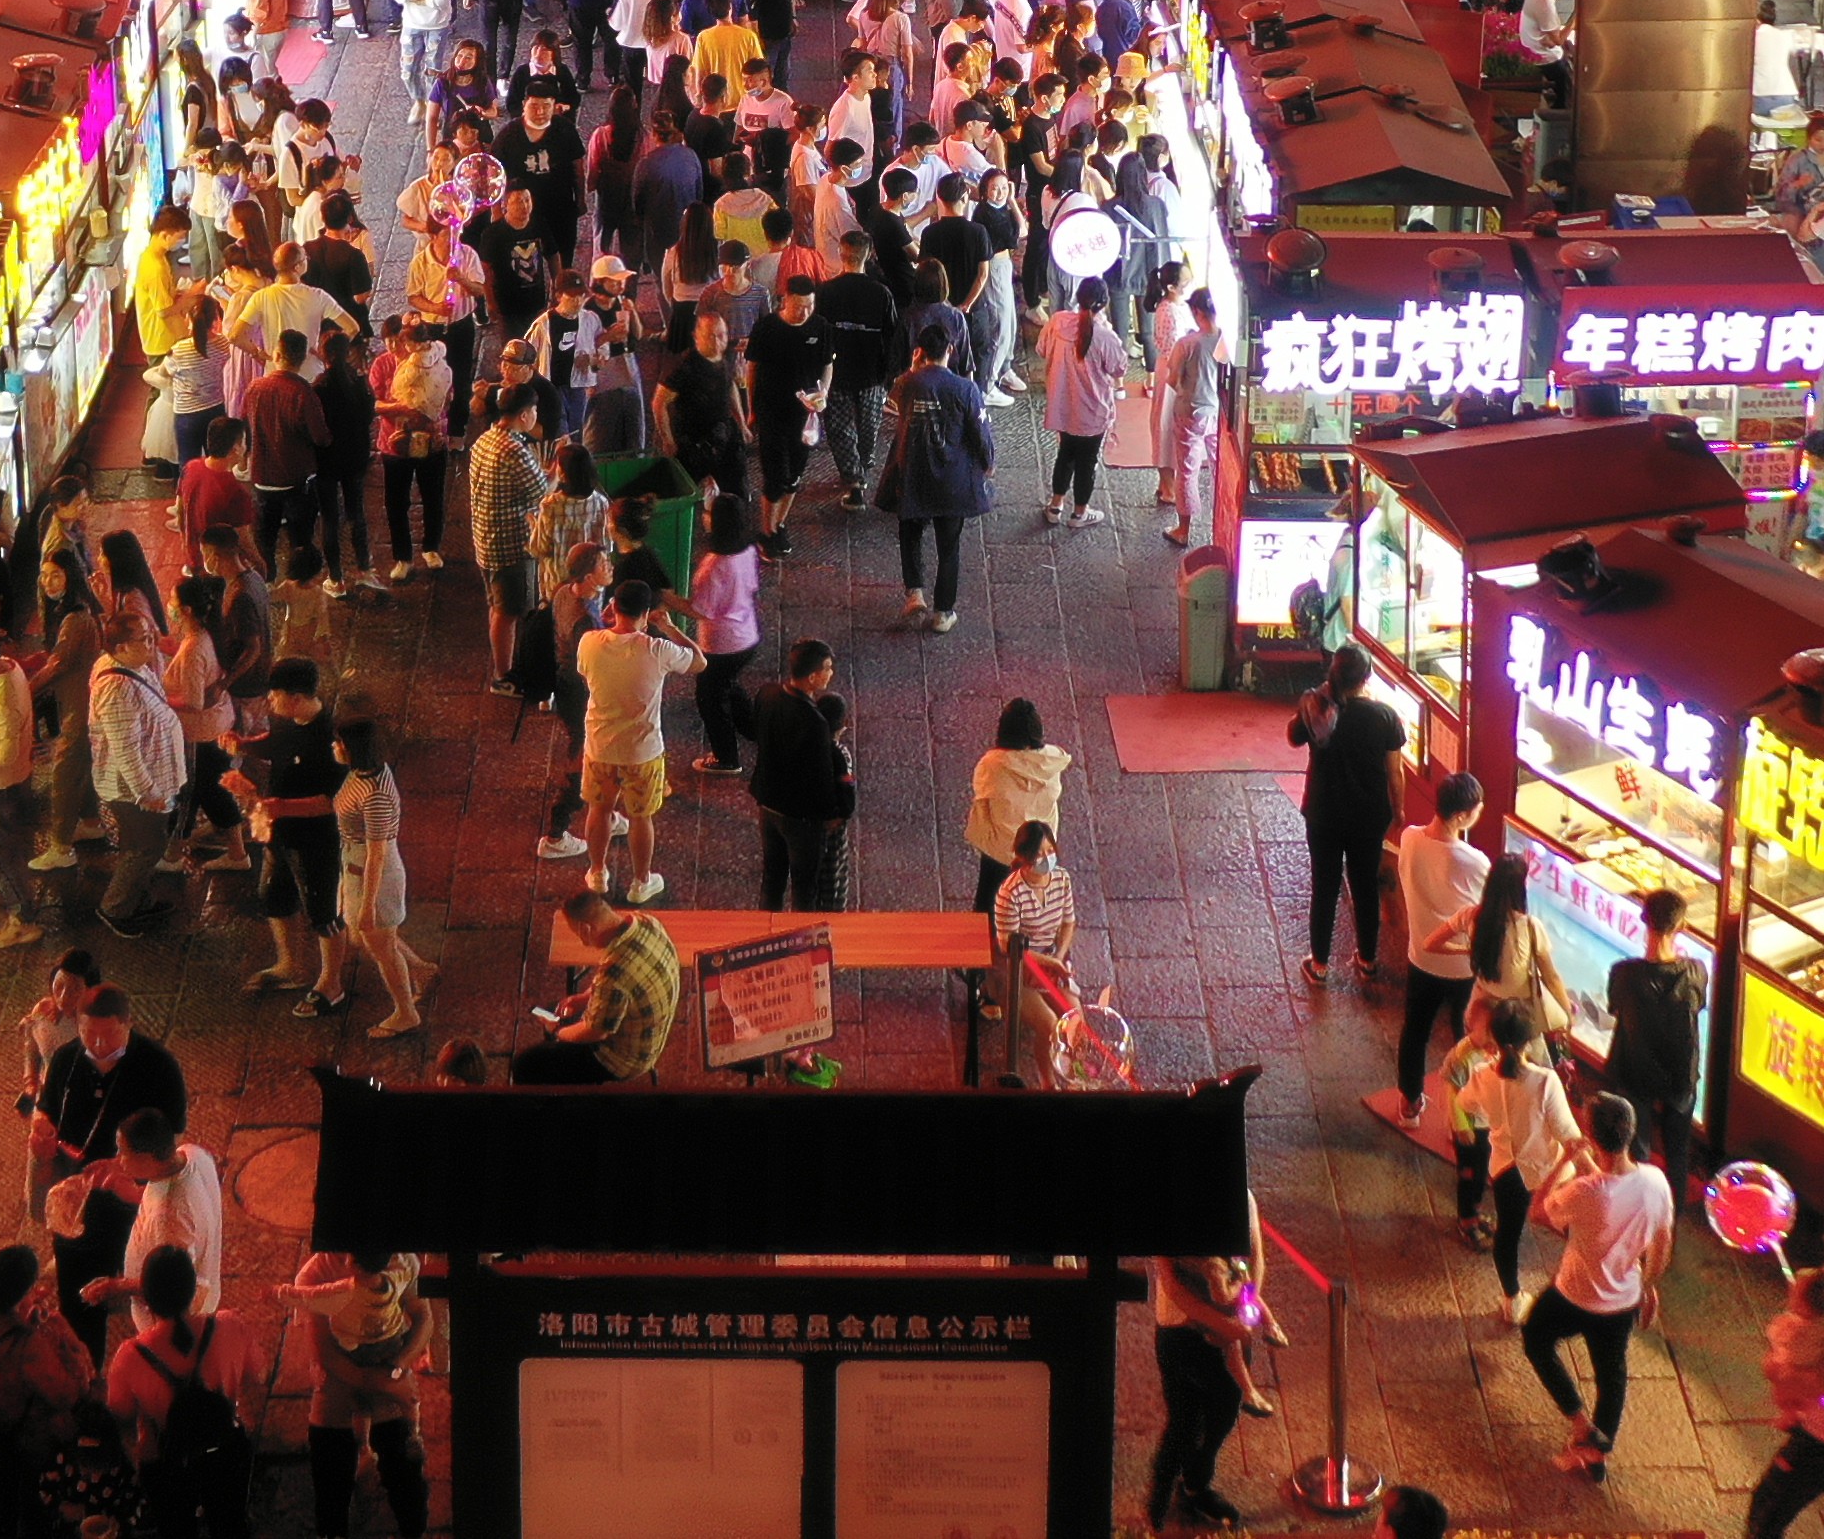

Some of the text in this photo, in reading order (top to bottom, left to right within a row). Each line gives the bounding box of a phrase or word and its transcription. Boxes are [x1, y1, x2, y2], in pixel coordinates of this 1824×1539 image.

[1262, 290, 1525, 396] 疯狂烤翅
[1256, 624, 1300, 640] 新奥
[537, 1311, 1032, 1340] 洛阳市古城管理委员会信息公示栏
